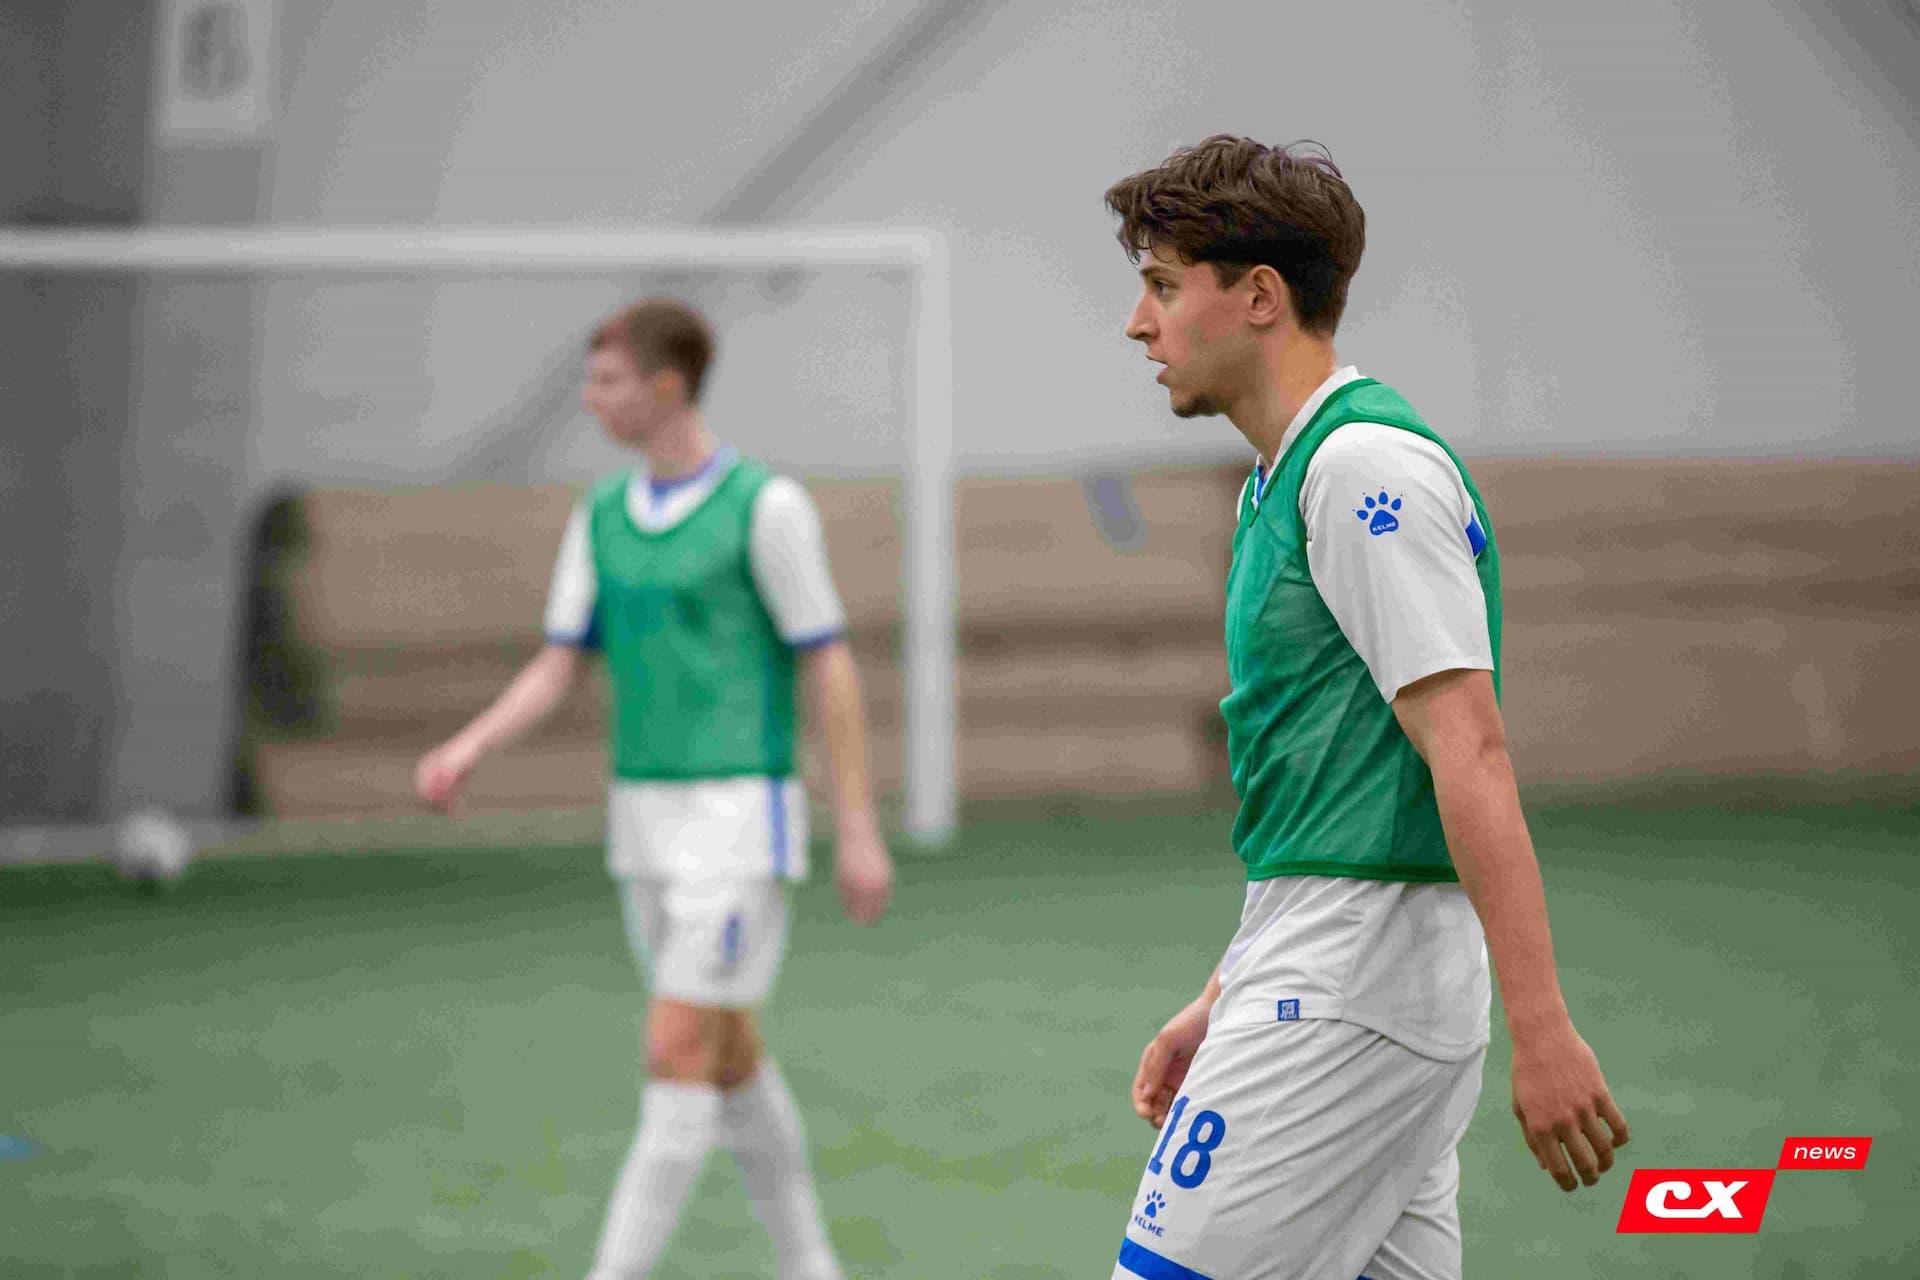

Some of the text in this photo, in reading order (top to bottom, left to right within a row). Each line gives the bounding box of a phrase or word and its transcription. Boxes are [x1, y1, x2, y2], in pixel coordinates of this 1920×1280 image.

[1373, 521, 1396, 532] KELME
[1149, 1096, 1226, 1189] 18
[1134, 1215, 1164, 1237] KELME
